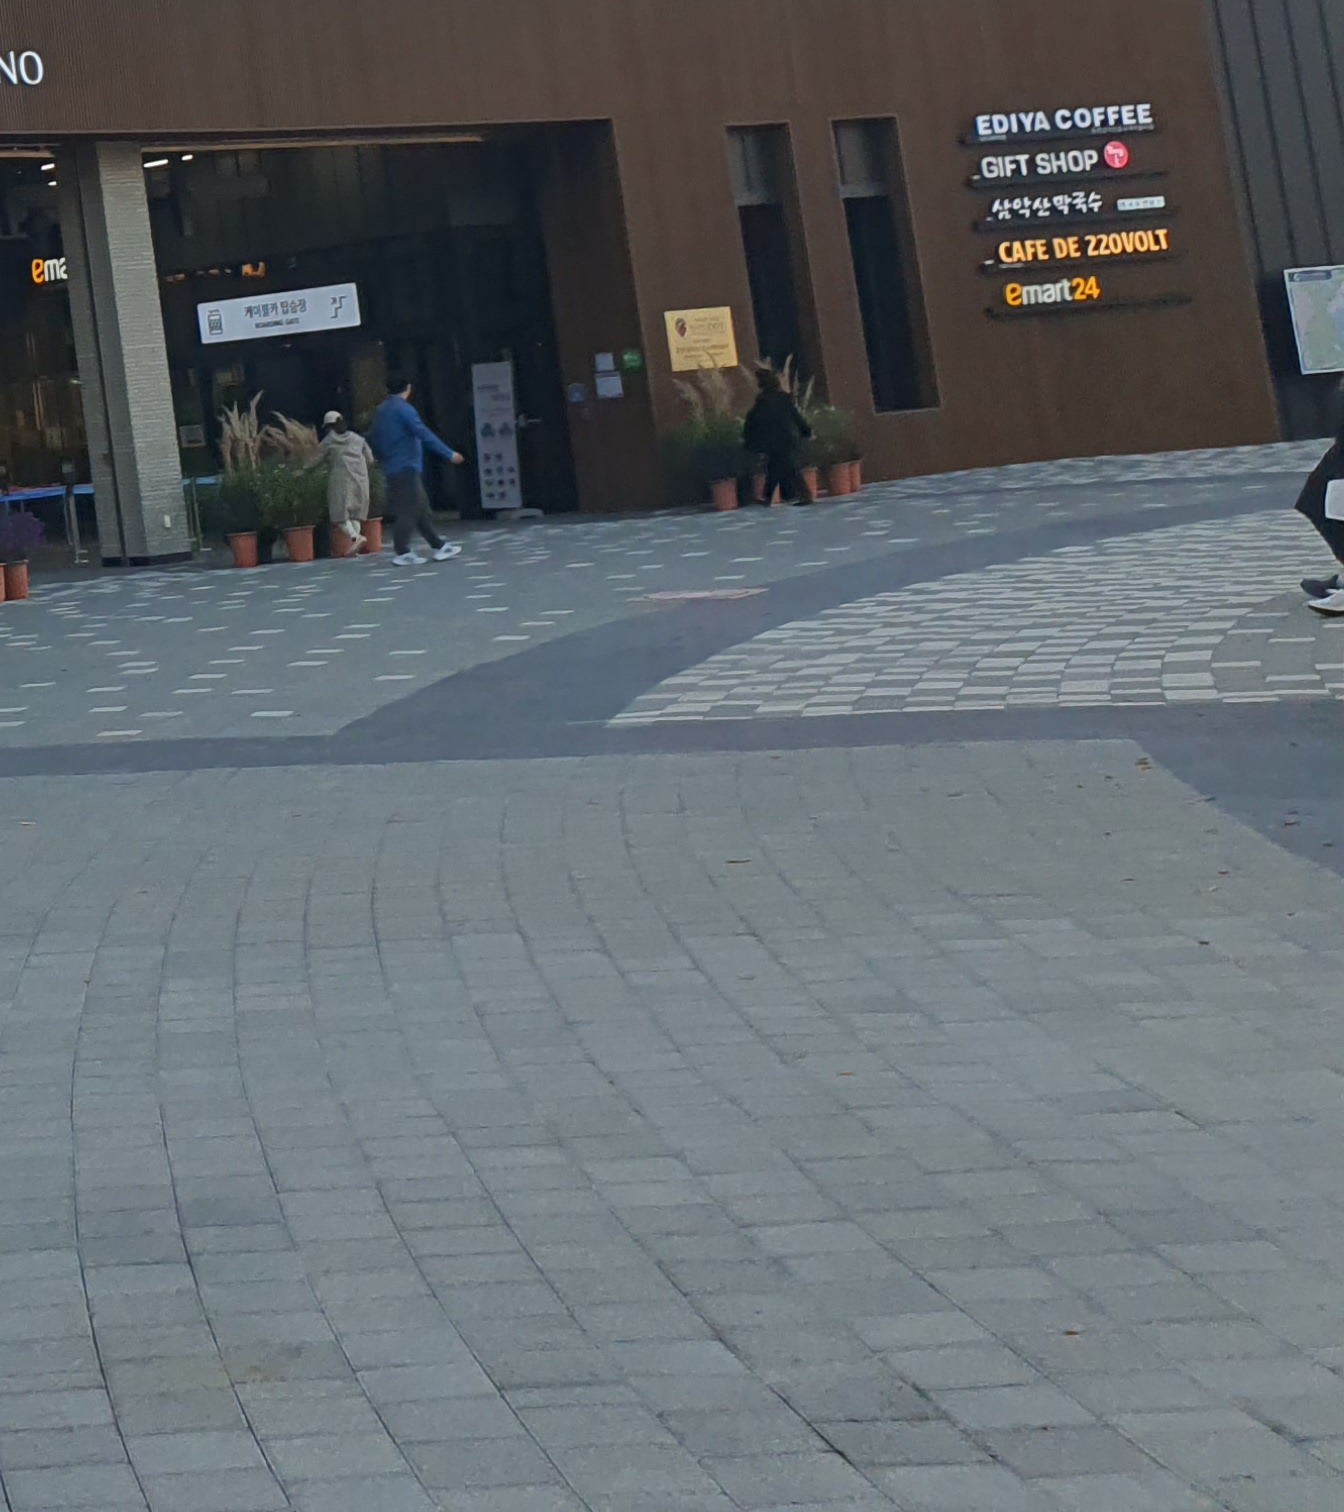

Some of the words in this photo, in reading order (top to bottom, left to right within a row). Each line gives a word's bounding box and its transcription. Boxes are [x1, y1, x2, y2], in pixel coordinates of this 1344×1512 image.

[976, 112, 1051, 137] EDIYA
[1054, 103, 1154, 131] COFFEE
[980, 153, 1030, 180] GIFT
[1035, 148, 1100, 175] SHOP
[998, 239, 1050, 264] CAFE
[1052, 235, 1082, 259] DE
[1084, 228, 1170, 257] 220VOLT
[1004, 274, 1101, 306] emart24
